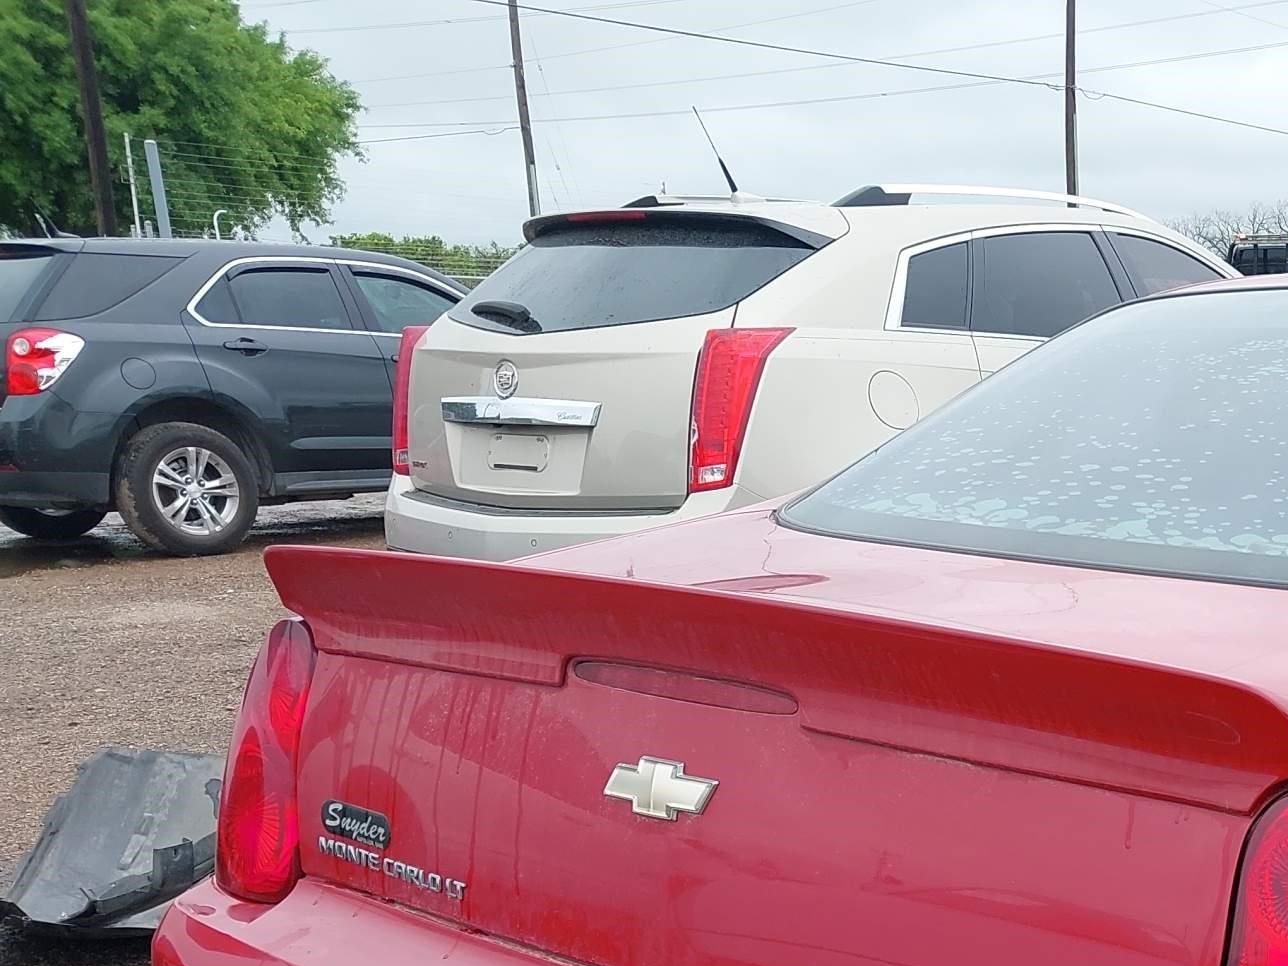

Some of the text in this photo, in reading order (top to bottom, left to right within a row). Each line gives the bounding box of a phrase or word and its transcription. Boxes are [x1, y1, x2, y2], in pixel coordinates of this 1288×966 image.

[325, 803, 387, 842] Snyder
[318, 837, 381, 871] MONTE
[383, 858, 442, 892] CARLO
[445, 878, 466, 900] LT
